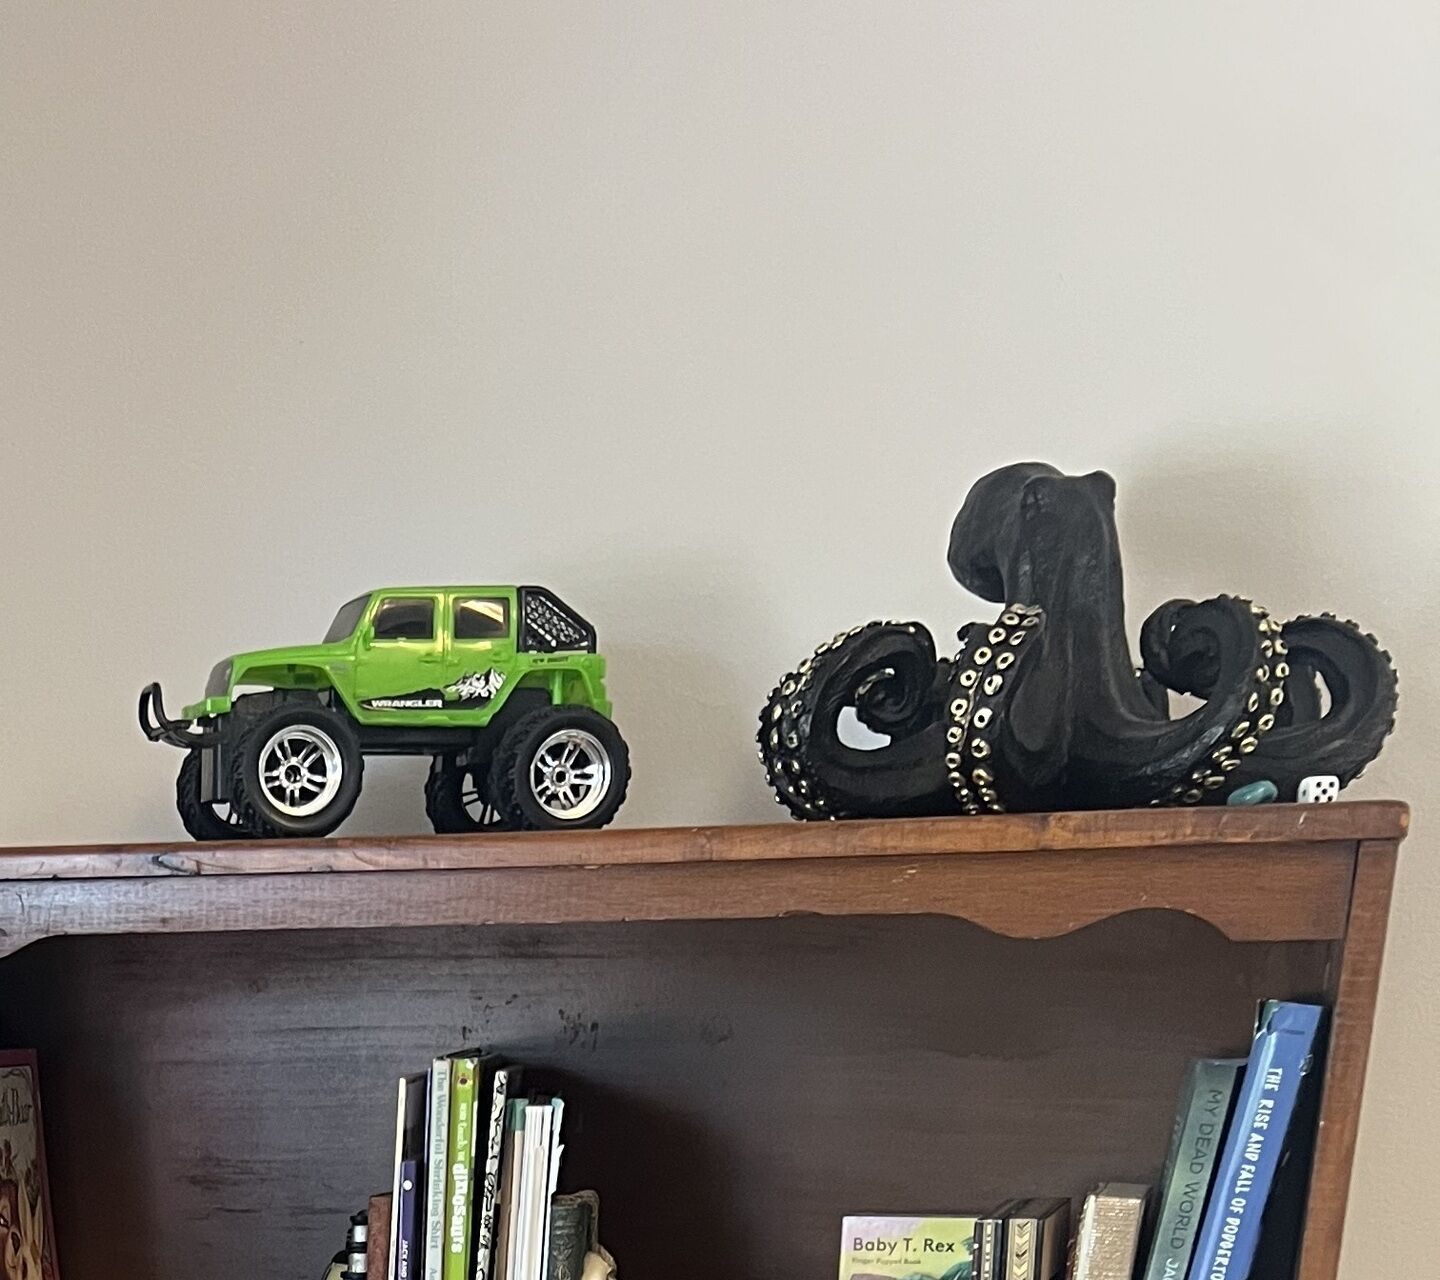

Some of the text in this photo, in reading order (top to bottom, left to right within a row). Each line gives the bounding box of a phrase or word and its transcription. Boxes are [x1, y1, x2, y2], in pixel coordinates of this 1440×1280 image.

[371, 699, 443, 708] WRANGLER
[1264, 1067, 1283, 1093] THE
[1253, 1099, 1275, 1130] RISE
[429, 1069, 448, 1249] The Wonderful Shrinking Shirt
[1244, 1134, 1264, 1163] AND
[1170, 1088, 1223, 1250] MY DEAD WORLD
[1238, 1162, 1258, 1196] FALL
[451, 1163, 470, 1254] dinosaurs
[1229, 1197, 1247, 1215] OF
[853, 1238, 955, 1256] Baby T. Rex
